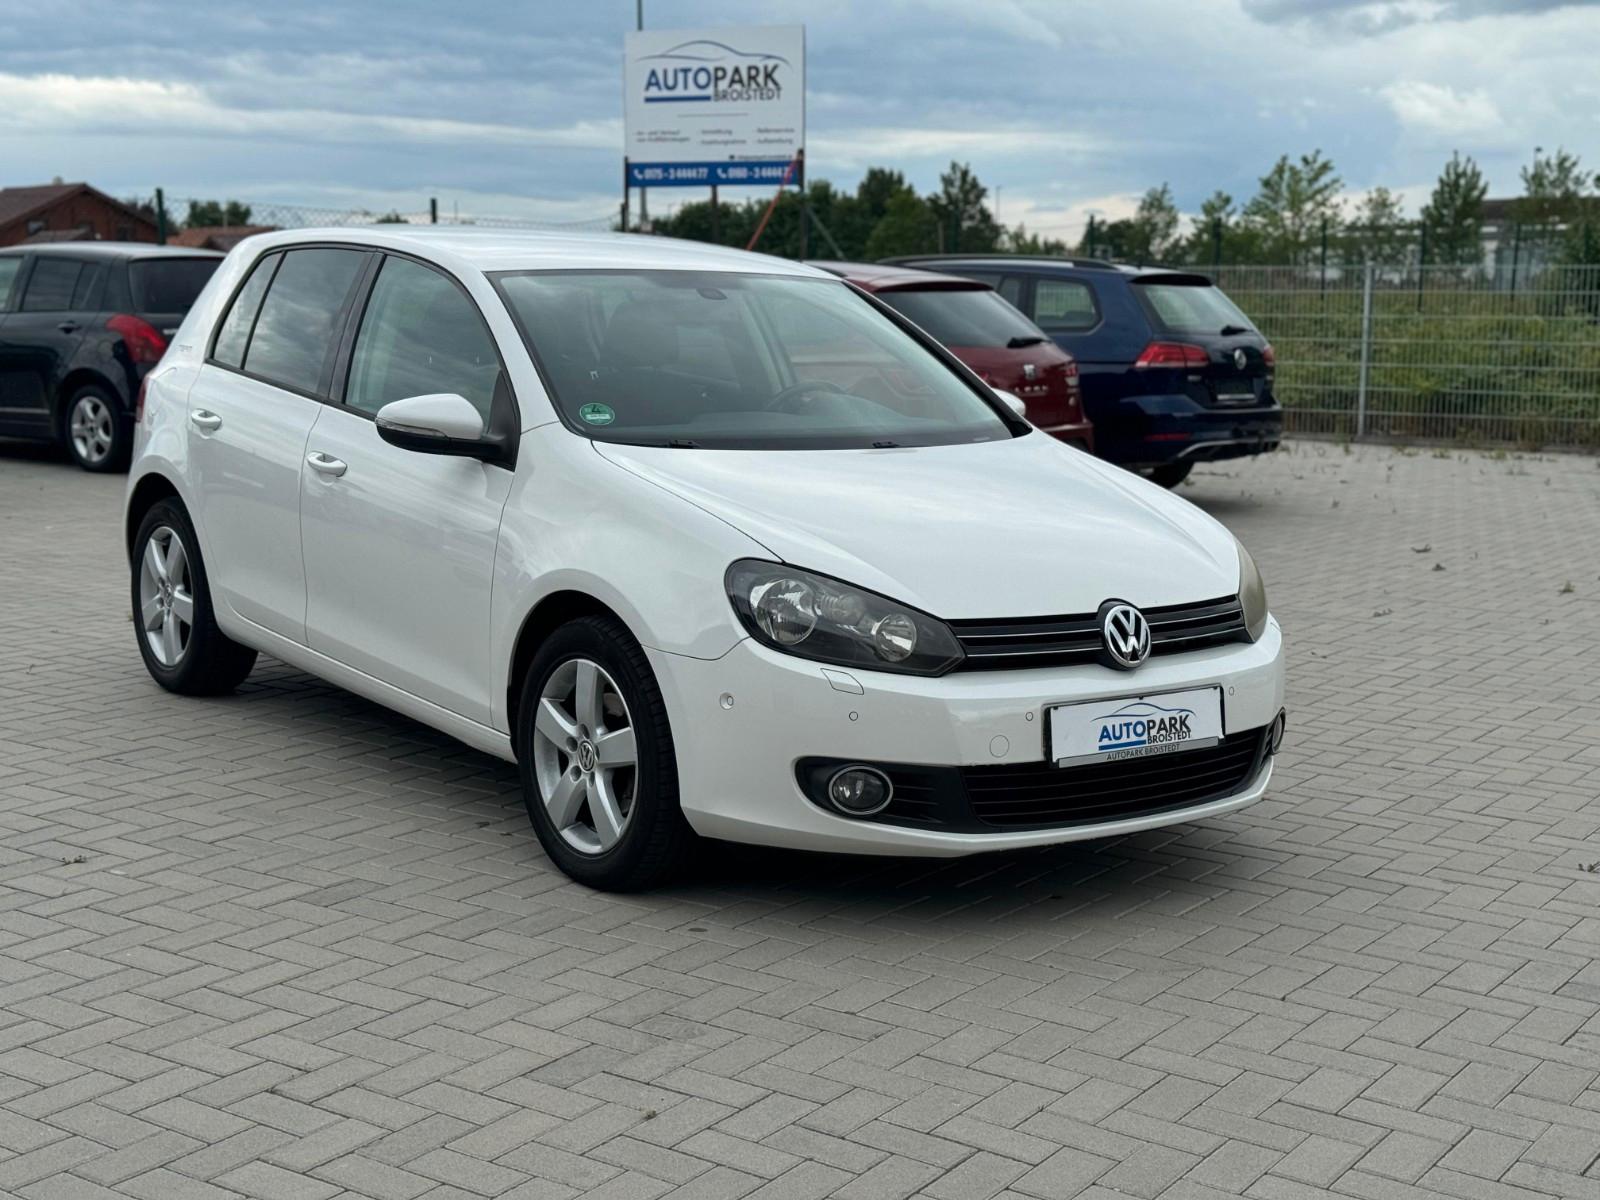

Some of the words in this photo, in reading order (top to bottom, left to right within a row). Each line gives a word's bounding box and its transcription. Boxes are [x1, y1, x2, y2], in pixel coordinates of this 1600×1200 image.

[644, 64, 782, 92] AUTOPARK
[713, 87, 782, 102] BROISTEDT
[1098, 714, 1191, 742] AUTOPARK
[1147, 730, 1192, 744] BROISTEDT
[1106, 749, 1143, 760] AUTOPARK
[1144, 743, 1181, 756] BROISTEDT
